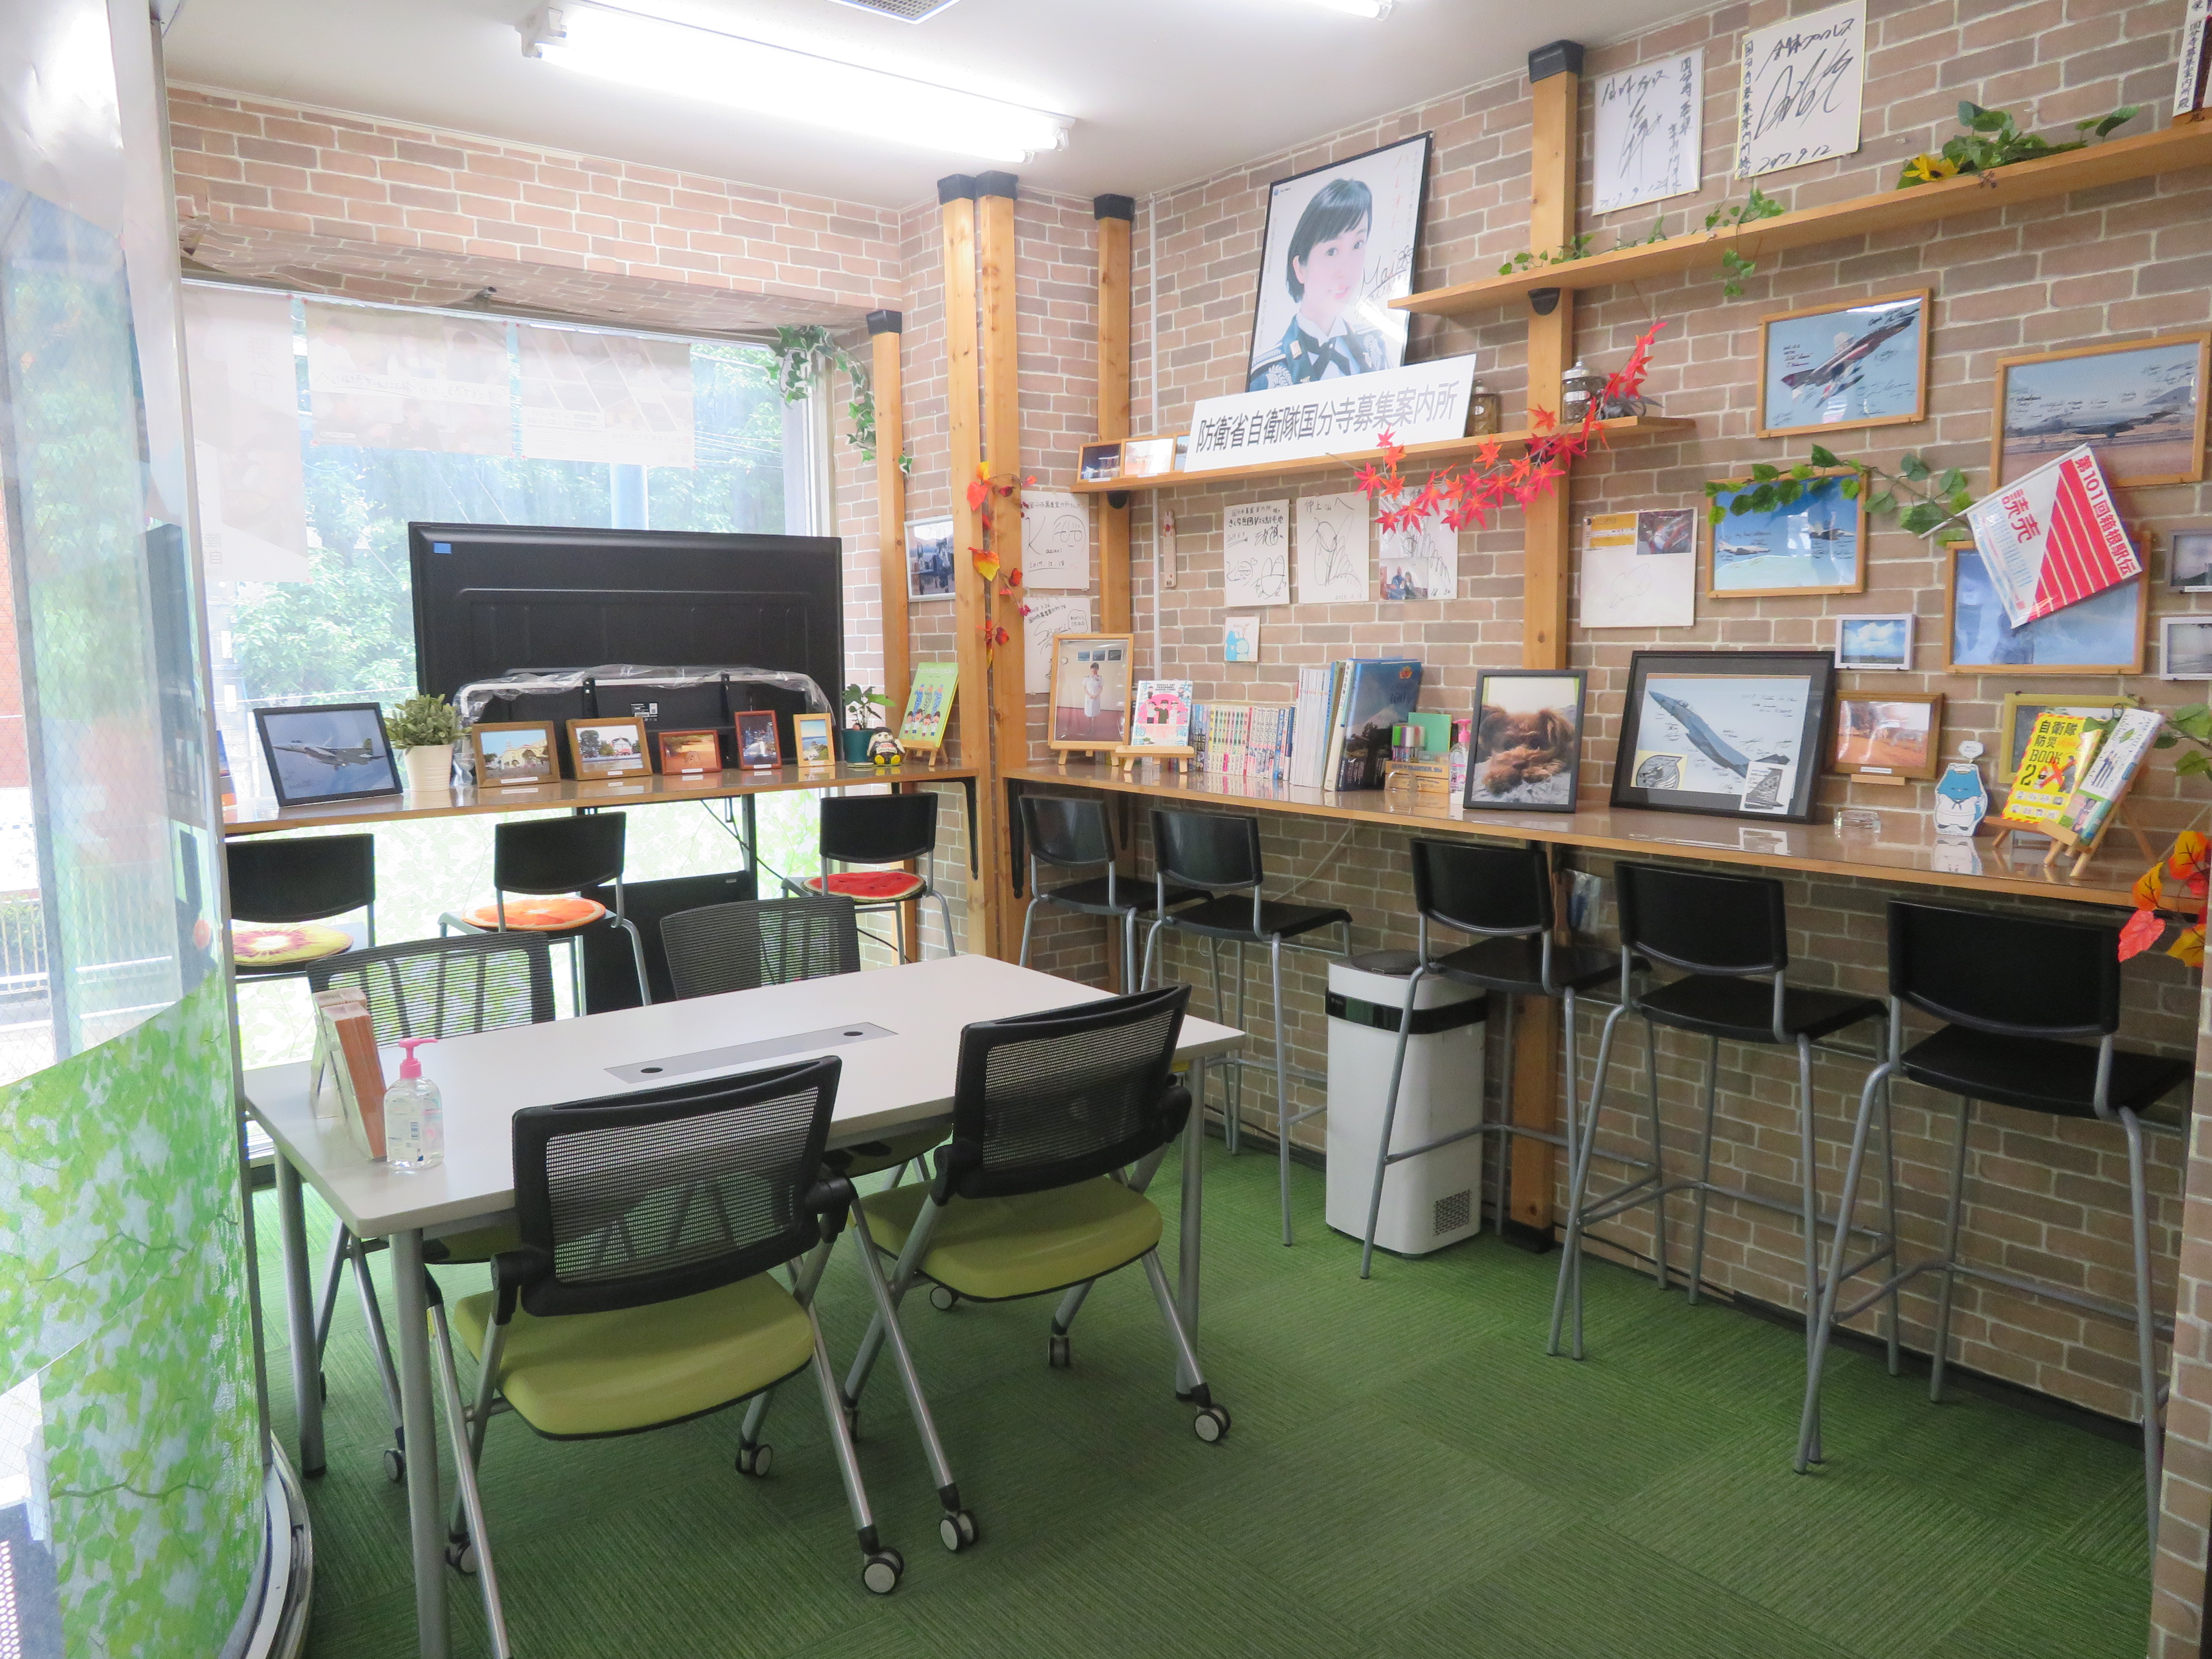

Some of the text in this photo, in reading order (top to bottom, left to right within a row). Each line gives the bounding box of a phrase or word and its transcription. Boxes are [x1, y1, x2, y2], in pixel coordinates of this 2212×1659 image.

[1196, 380, 1459, 453] 防衛省自衛隊国分寺募集案内所
[2002, 488, 2042, 544] 読売
[2075, 455, 2137, 576] 第101回箱根駅伝
[2040, 720, 2078, 736] 自衛隊
[2034, 734, 2058, 748] 防災
[2029, 748, 2064, 765] BOOK
[2020, 764, 2037, 786] 2
